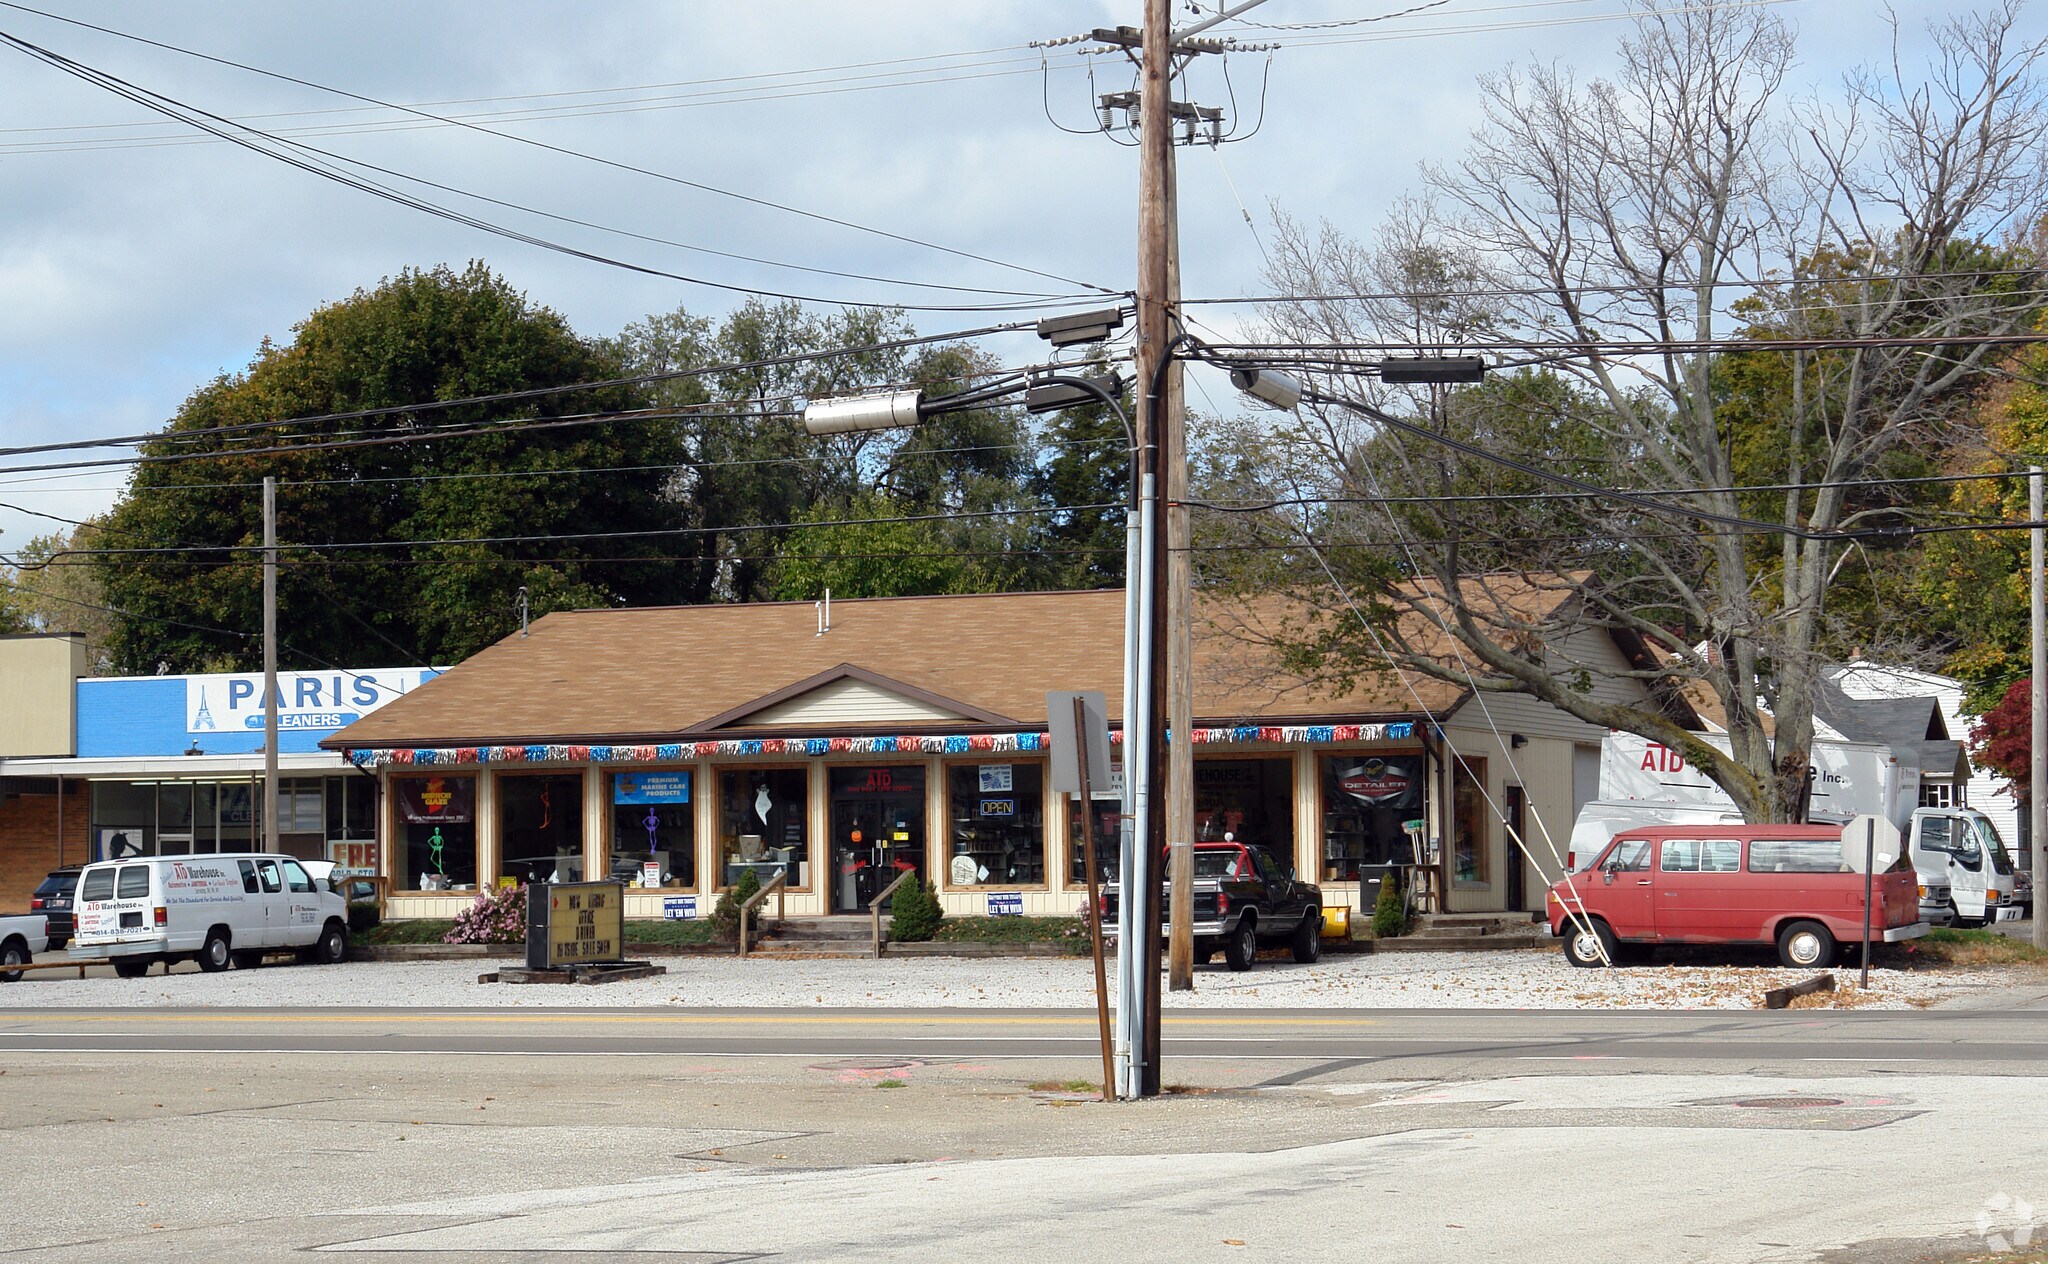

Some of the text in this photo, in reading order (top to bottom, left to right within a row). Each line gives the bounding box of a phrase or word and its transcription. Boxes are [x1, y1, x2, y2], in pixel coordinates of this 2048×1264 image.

[229, 675, 379, 710] PARIS
[265, 713, 341, 727] LEANERS
[1641, 743, 1684, 773] ATD
[1823, 770, 1846, 784] Inc.
[866, 769, 892, 786] ATD
[1195, 768, 1241, 781] EHOUSE
[1344, 781, 1407, 789] DETAILER
[982, 801, 1012, 814] OPEN
[174, 863, 188, 879] ATD
[186, 865, 220, 880] Warehouse
[87, 901, 100, 911] ATD
[101, 902, 137, 911] Warehouse
[989, 904, 998, 914] LET
[665, 908, 674, 918] LET
[576, 925, 595, 941] DRIVER
